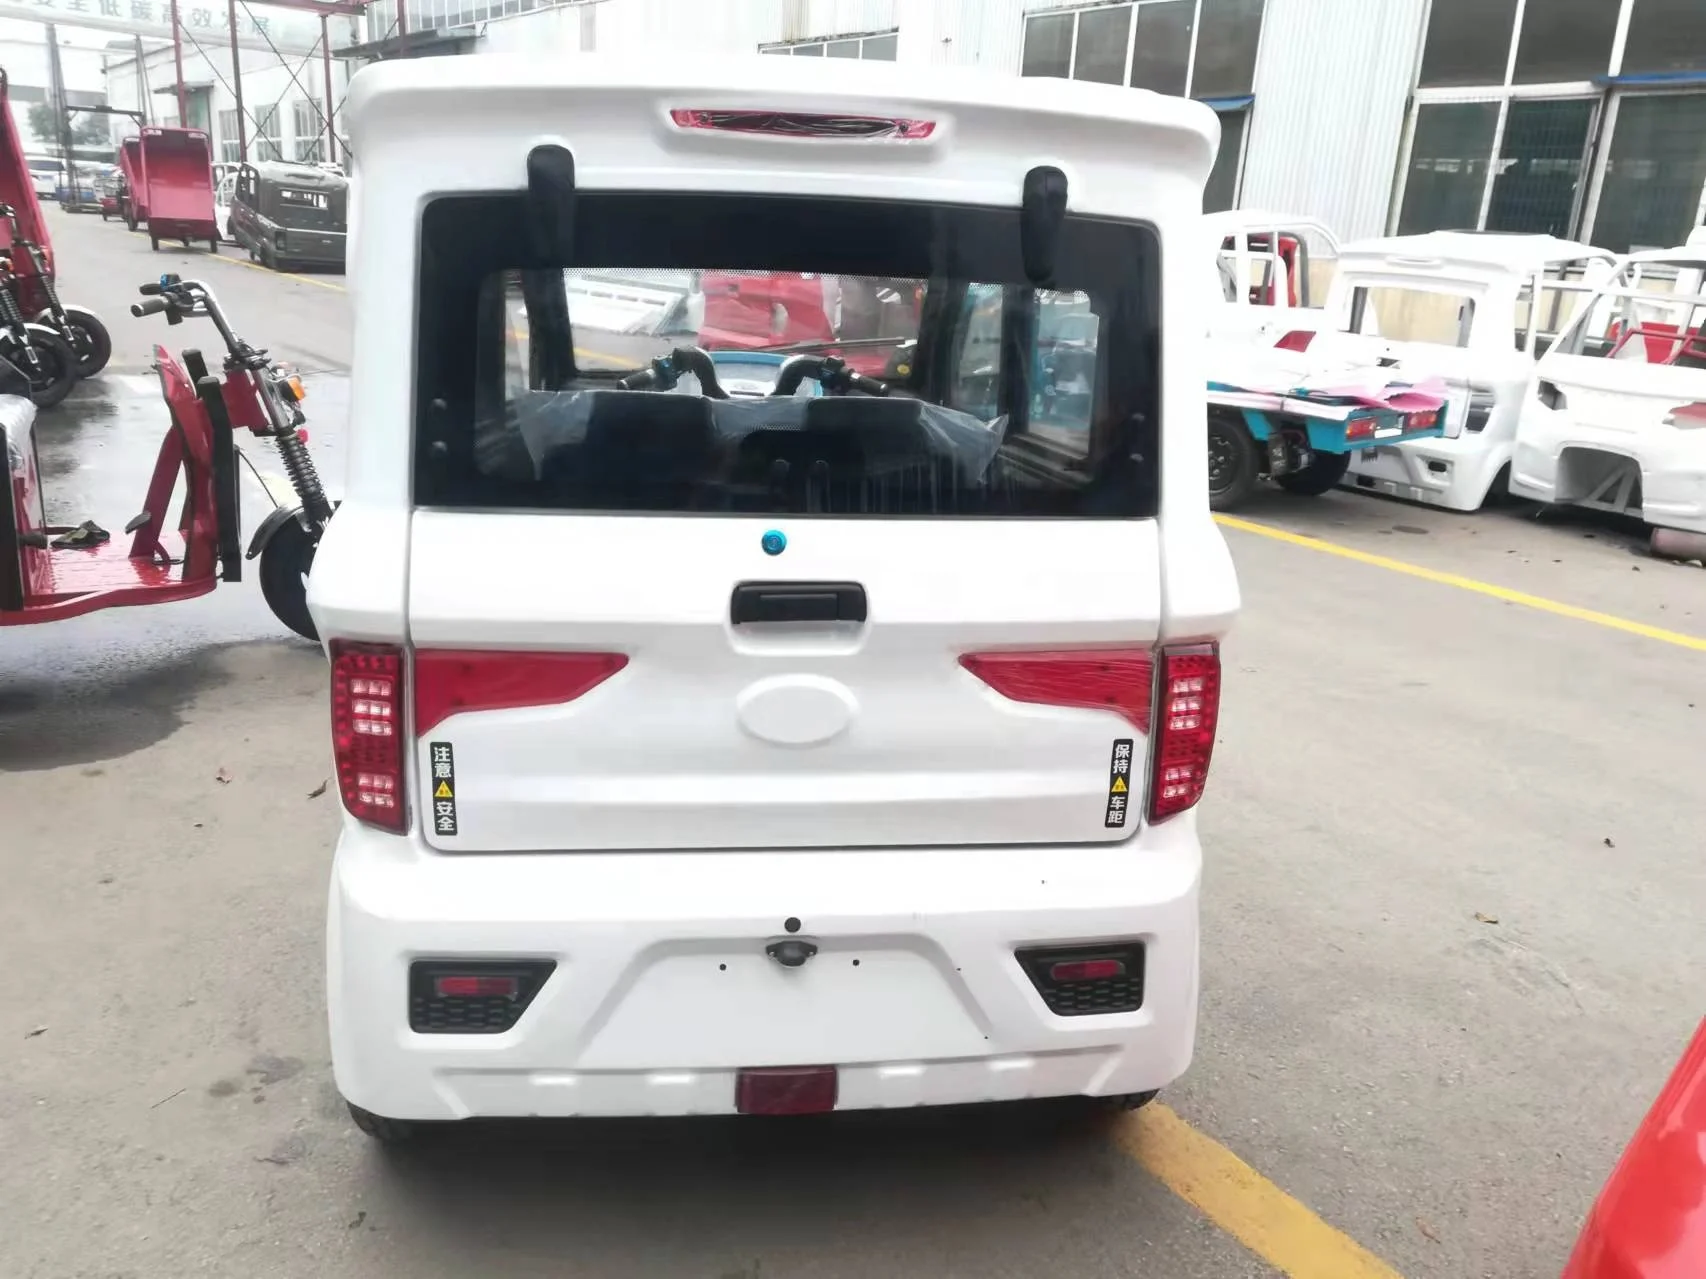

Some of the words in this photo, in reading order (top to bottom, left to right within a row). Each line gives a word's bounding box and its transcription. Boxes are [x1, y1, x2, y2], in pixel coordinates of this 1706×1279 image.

[434, 746, 452, 778] 注意
[1112, 744, 1130, 774] 保持
[437, 802, 455, 831] 安全
[1108, 796, 1125, 824] 车距
